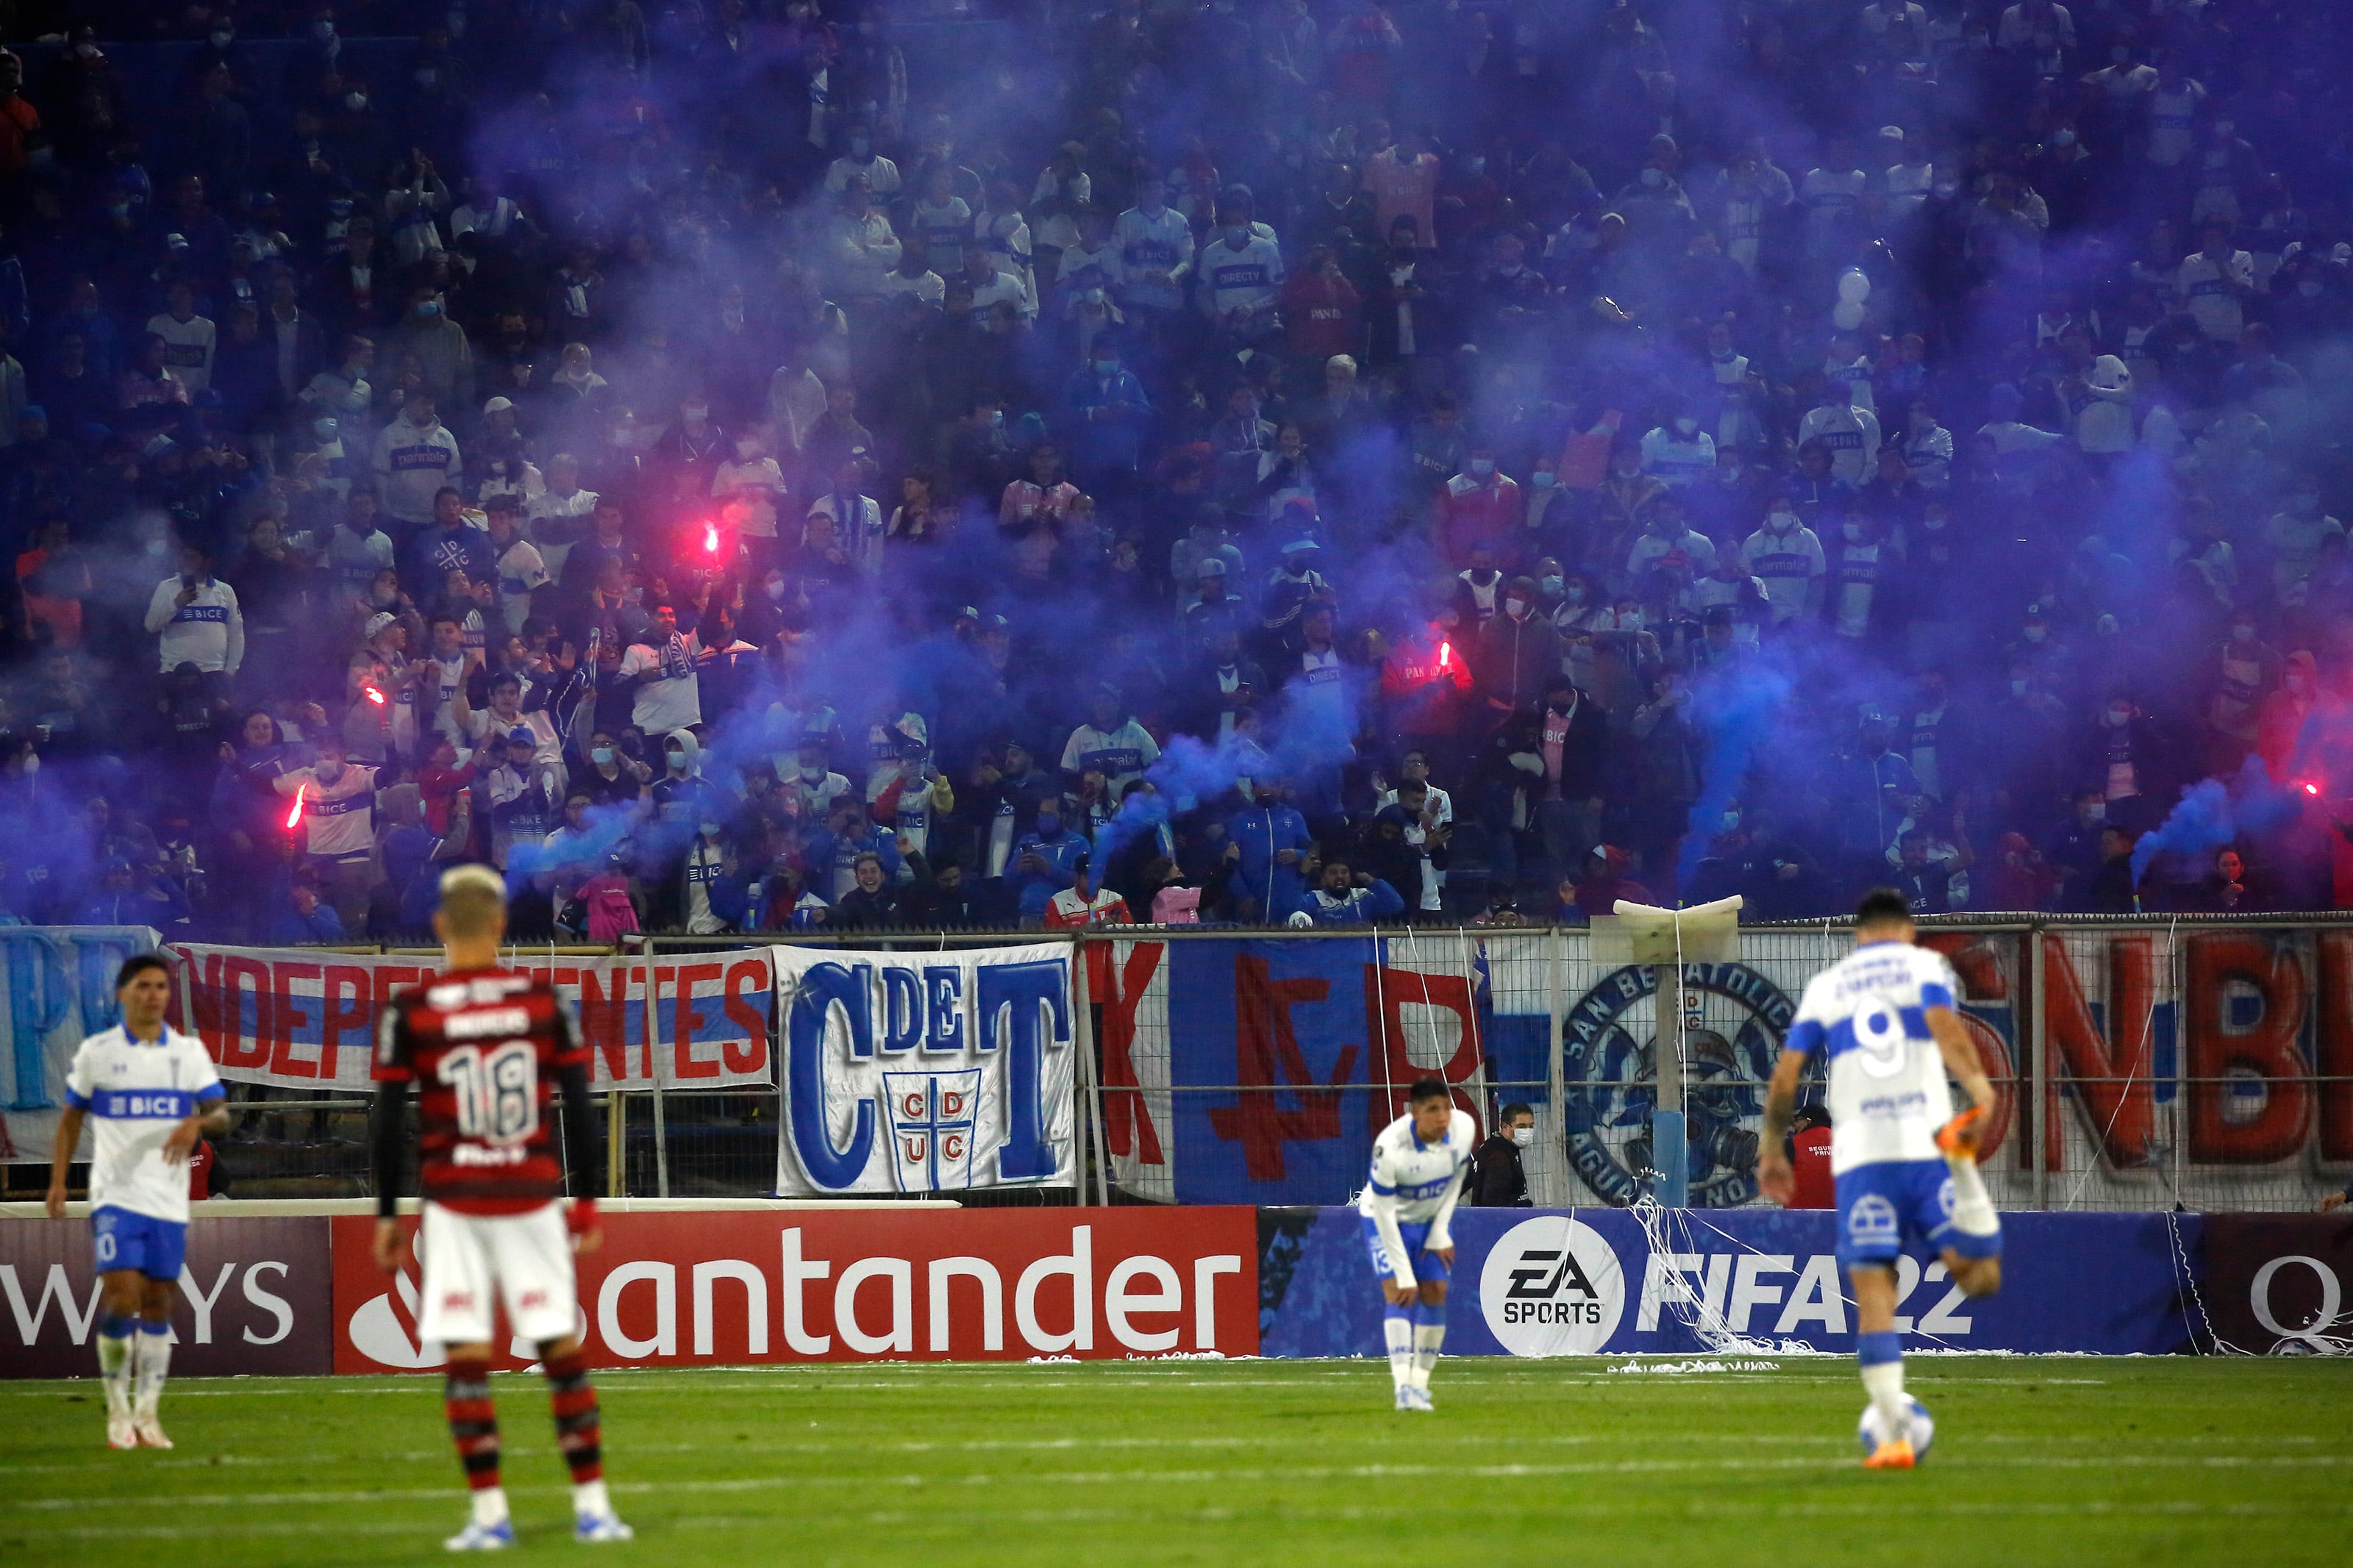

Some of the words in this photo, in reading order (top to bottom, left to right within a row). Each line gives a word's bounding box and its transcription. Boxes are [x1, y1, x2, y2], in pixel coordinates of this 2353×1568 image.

[1220, 271, 1260, 284] DIRECTV
[1423, 459, 1448, 472] BICE
[195, 609, 223, 619] BICE
[1309, 670, 1341, 683] DIRECT
[1546, 731, 1565, 743] BIC
[881, 747, 900, 757] BIC
[319, 803, 347, 815] BICE
[519, 815, 542, 824] BICE
[907, 816, 924, 826] BIC
[835, 855, 857, 864] DIRE
[166, 945, 768, 1084] NDEPNTES
[1563, 995, 1613, 1062] SAN
[1852, 996, 1907, 1078] 9
[438, 1039, 540, 1148] 18
[129, 1096, 180, 1116] BICE
[1418, 1182, 1447, 1200] BIC
[1505, 1250, 1599, 1299] EA
[1635, 1253, 1848, 1334] FIFA
[0, 1261, 294, 1346] WYS
[1504, 1302, 1601, 1324] SPORTS
